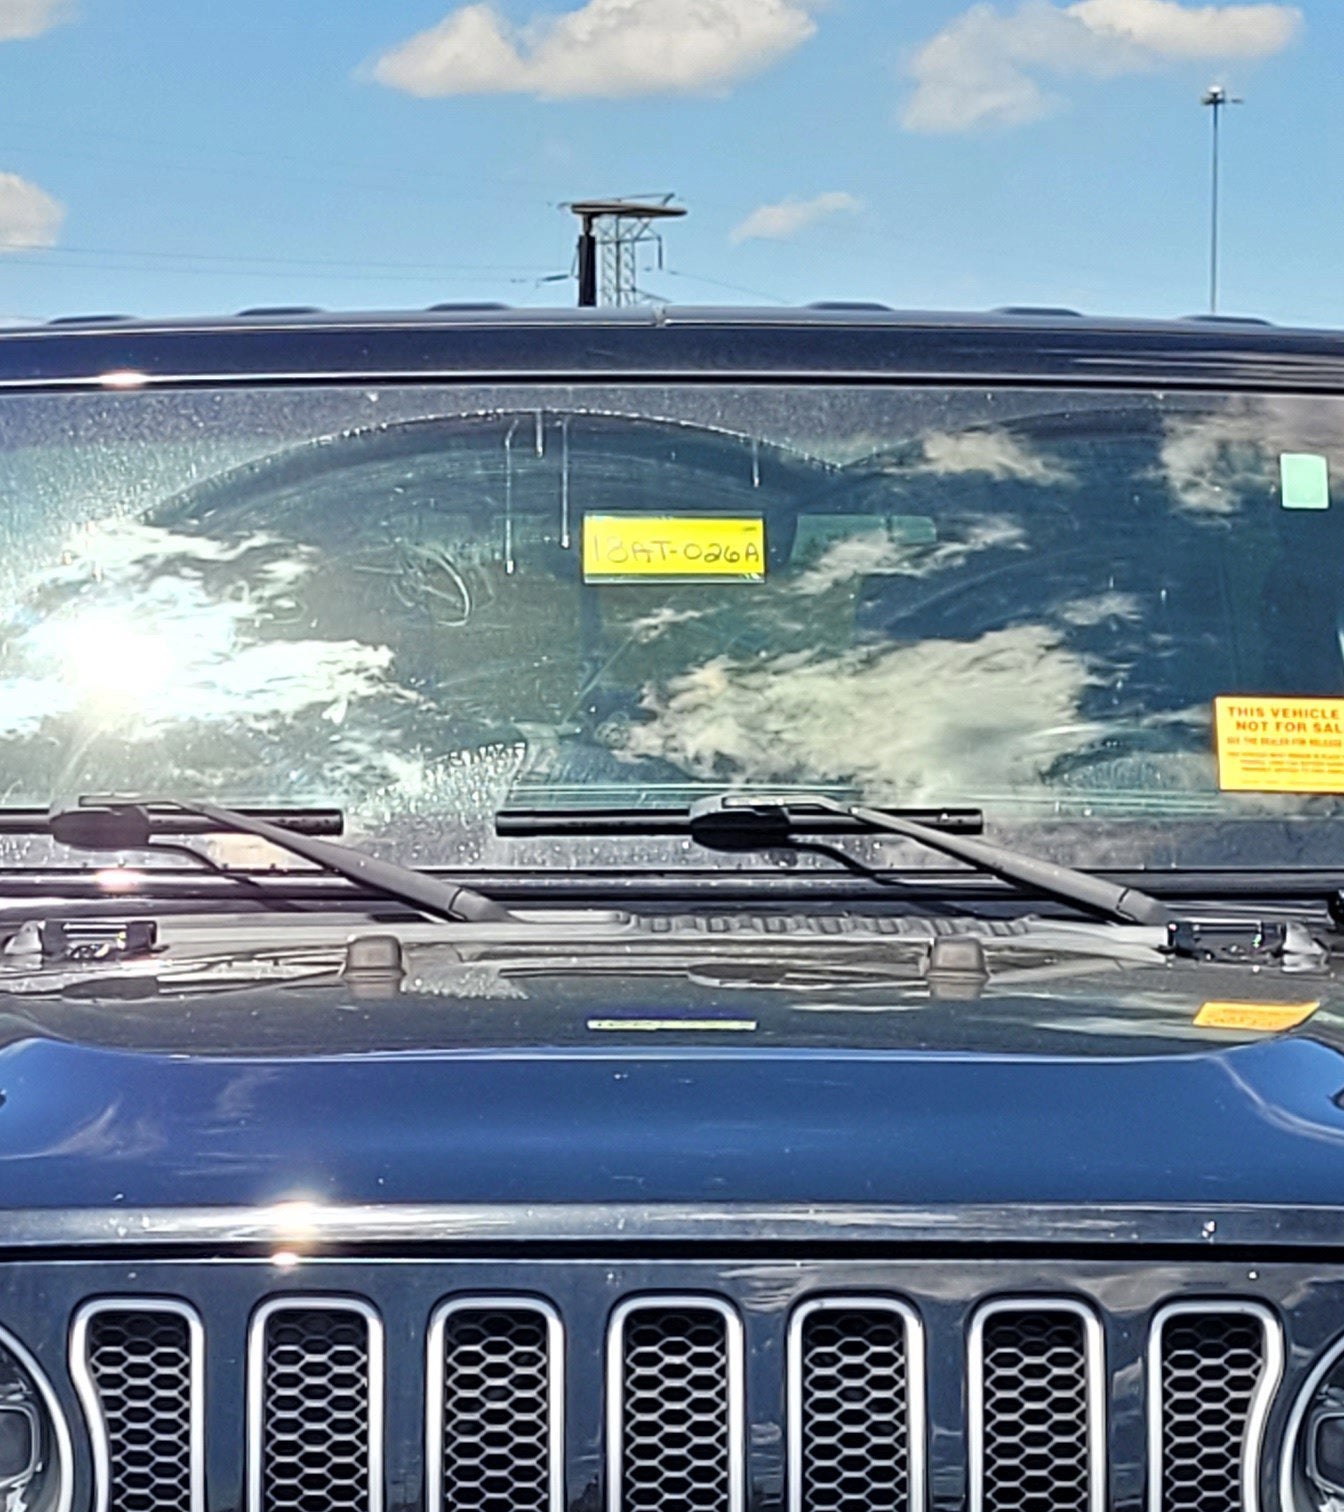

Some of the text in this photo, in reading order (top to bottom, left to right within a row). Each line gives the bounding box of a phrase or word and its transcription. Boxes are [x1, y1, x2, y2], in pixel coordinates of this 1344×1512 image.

[1227, 706, 1265, 718] THIS
[1270, 707, 1340, 720] VEHICLE
[1235, 720, 1269, 732] NOT
[1275, 721, 1308, 733] FOR
